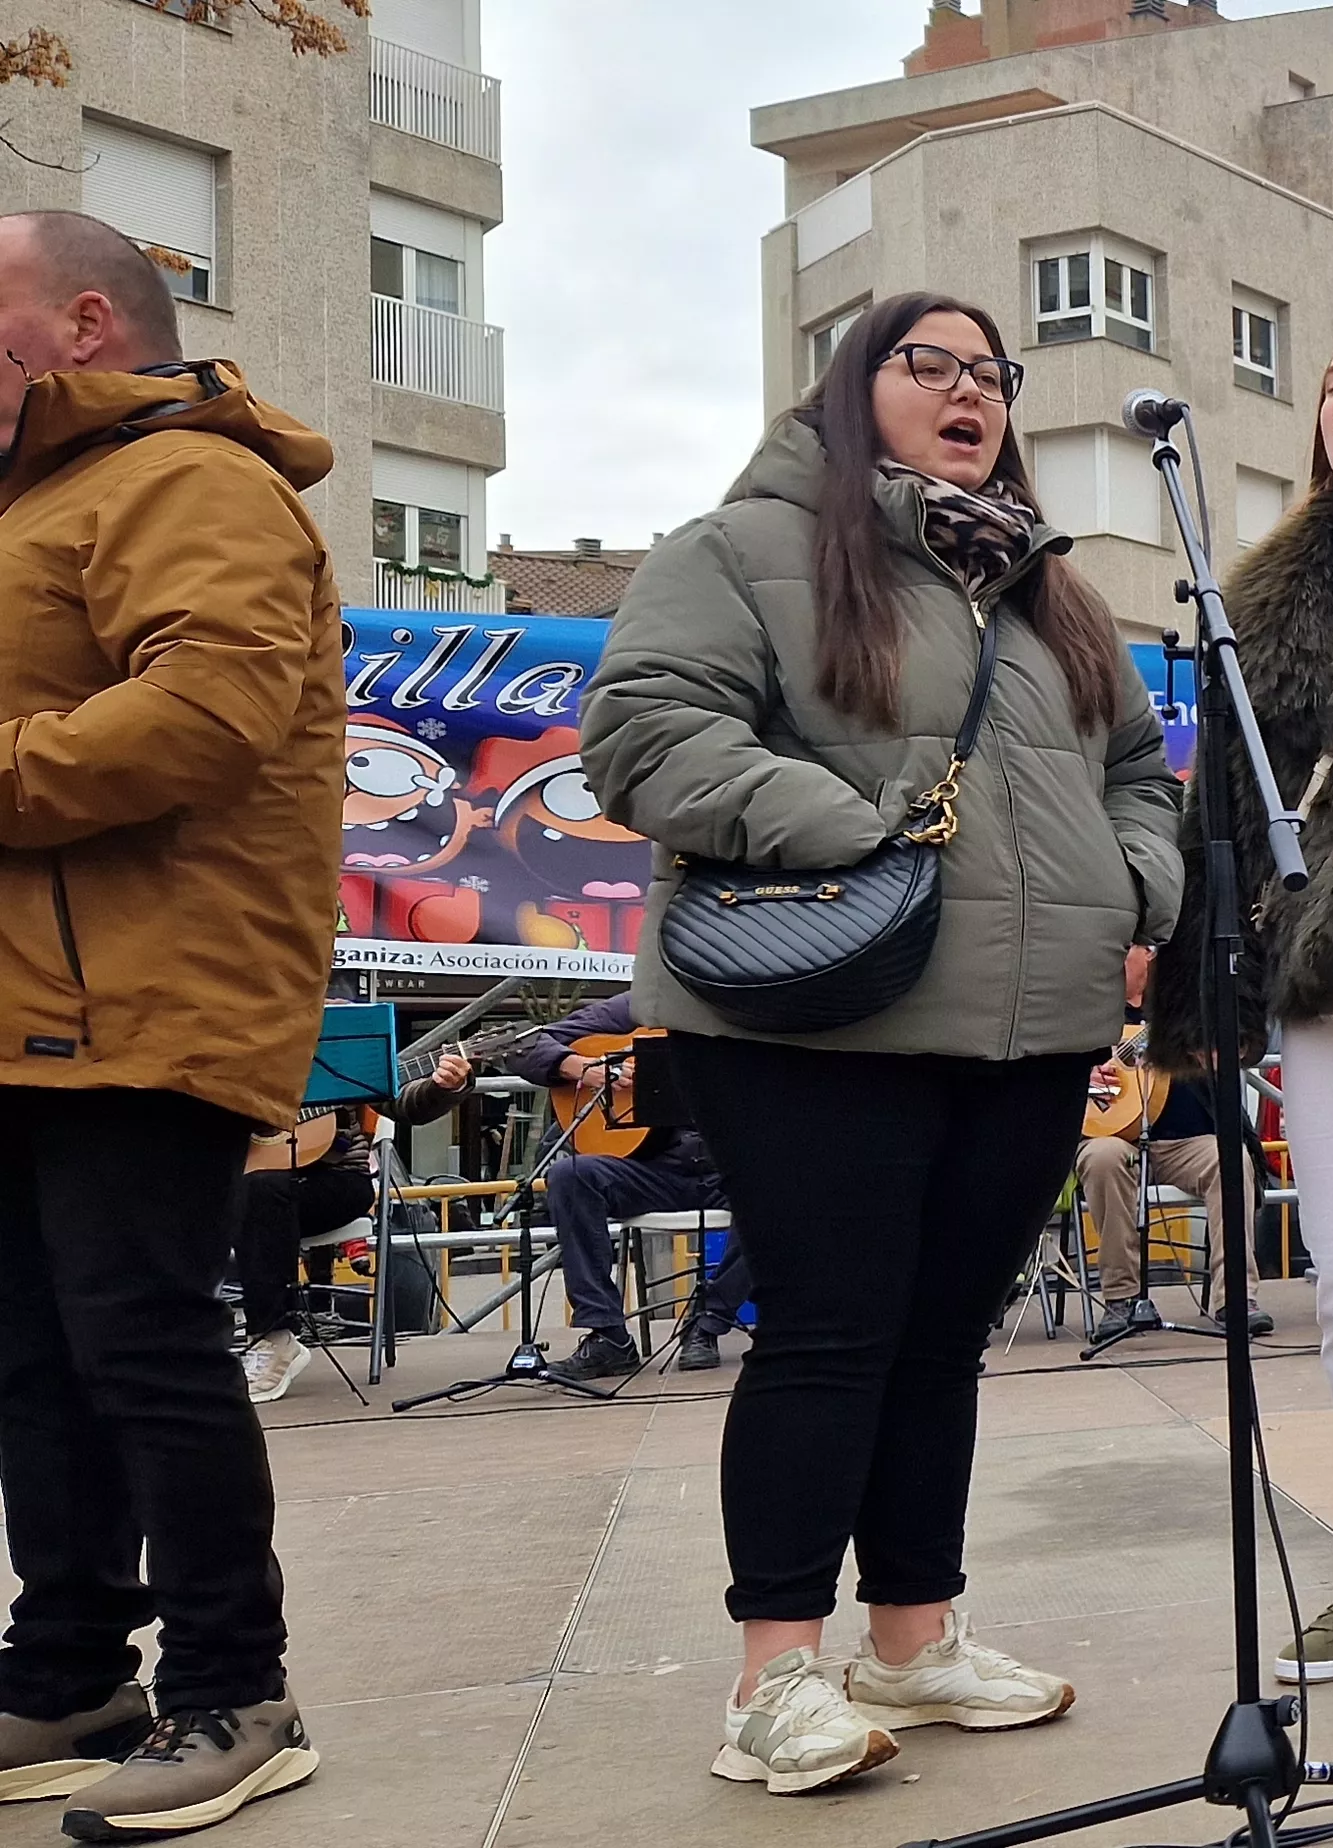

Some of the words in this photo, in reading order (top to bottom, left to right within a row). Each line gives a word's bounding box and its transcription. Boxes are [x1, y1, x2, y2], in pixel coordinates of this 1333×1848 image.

[754, 885, 801, 895] GUESS
[430, 950, 549, 973] Asociación
[557, 955, 635, 975] Folklór
